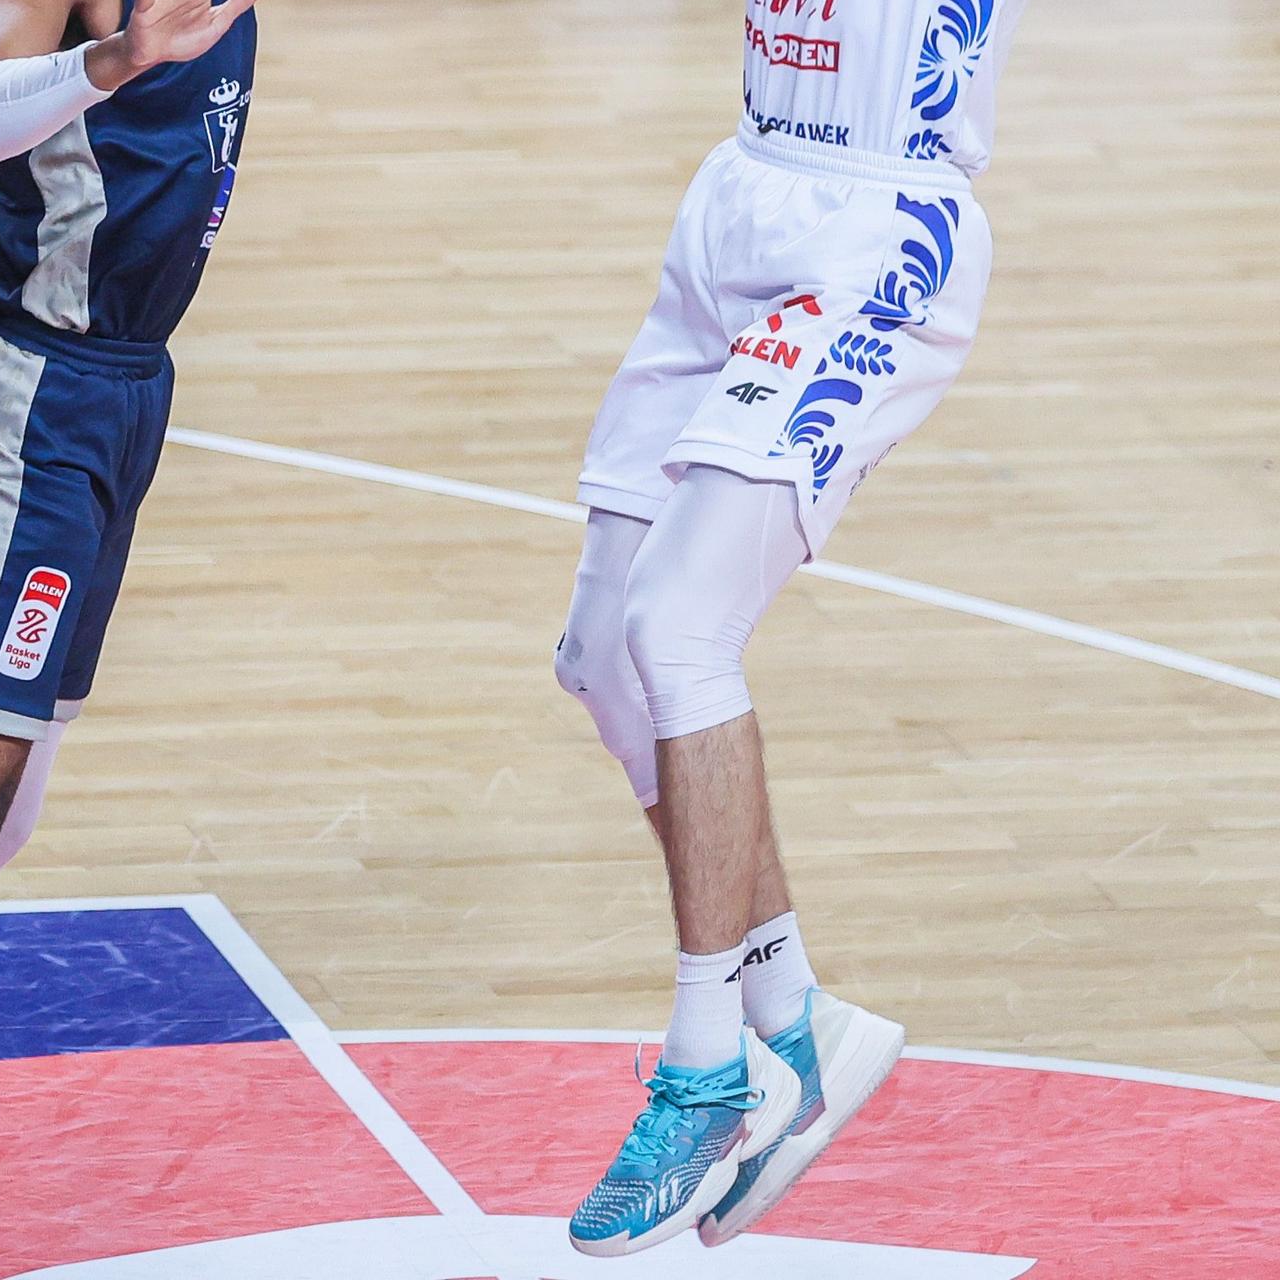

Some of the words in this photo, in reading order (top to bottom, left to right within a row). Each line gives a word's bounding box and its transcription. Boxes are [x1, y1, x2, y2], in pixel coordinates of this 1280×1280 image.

[29, 582, 64, 598] ORLEN
[5, 644, 42, 662] Basket
[9, 656, 31, 670] Liga
